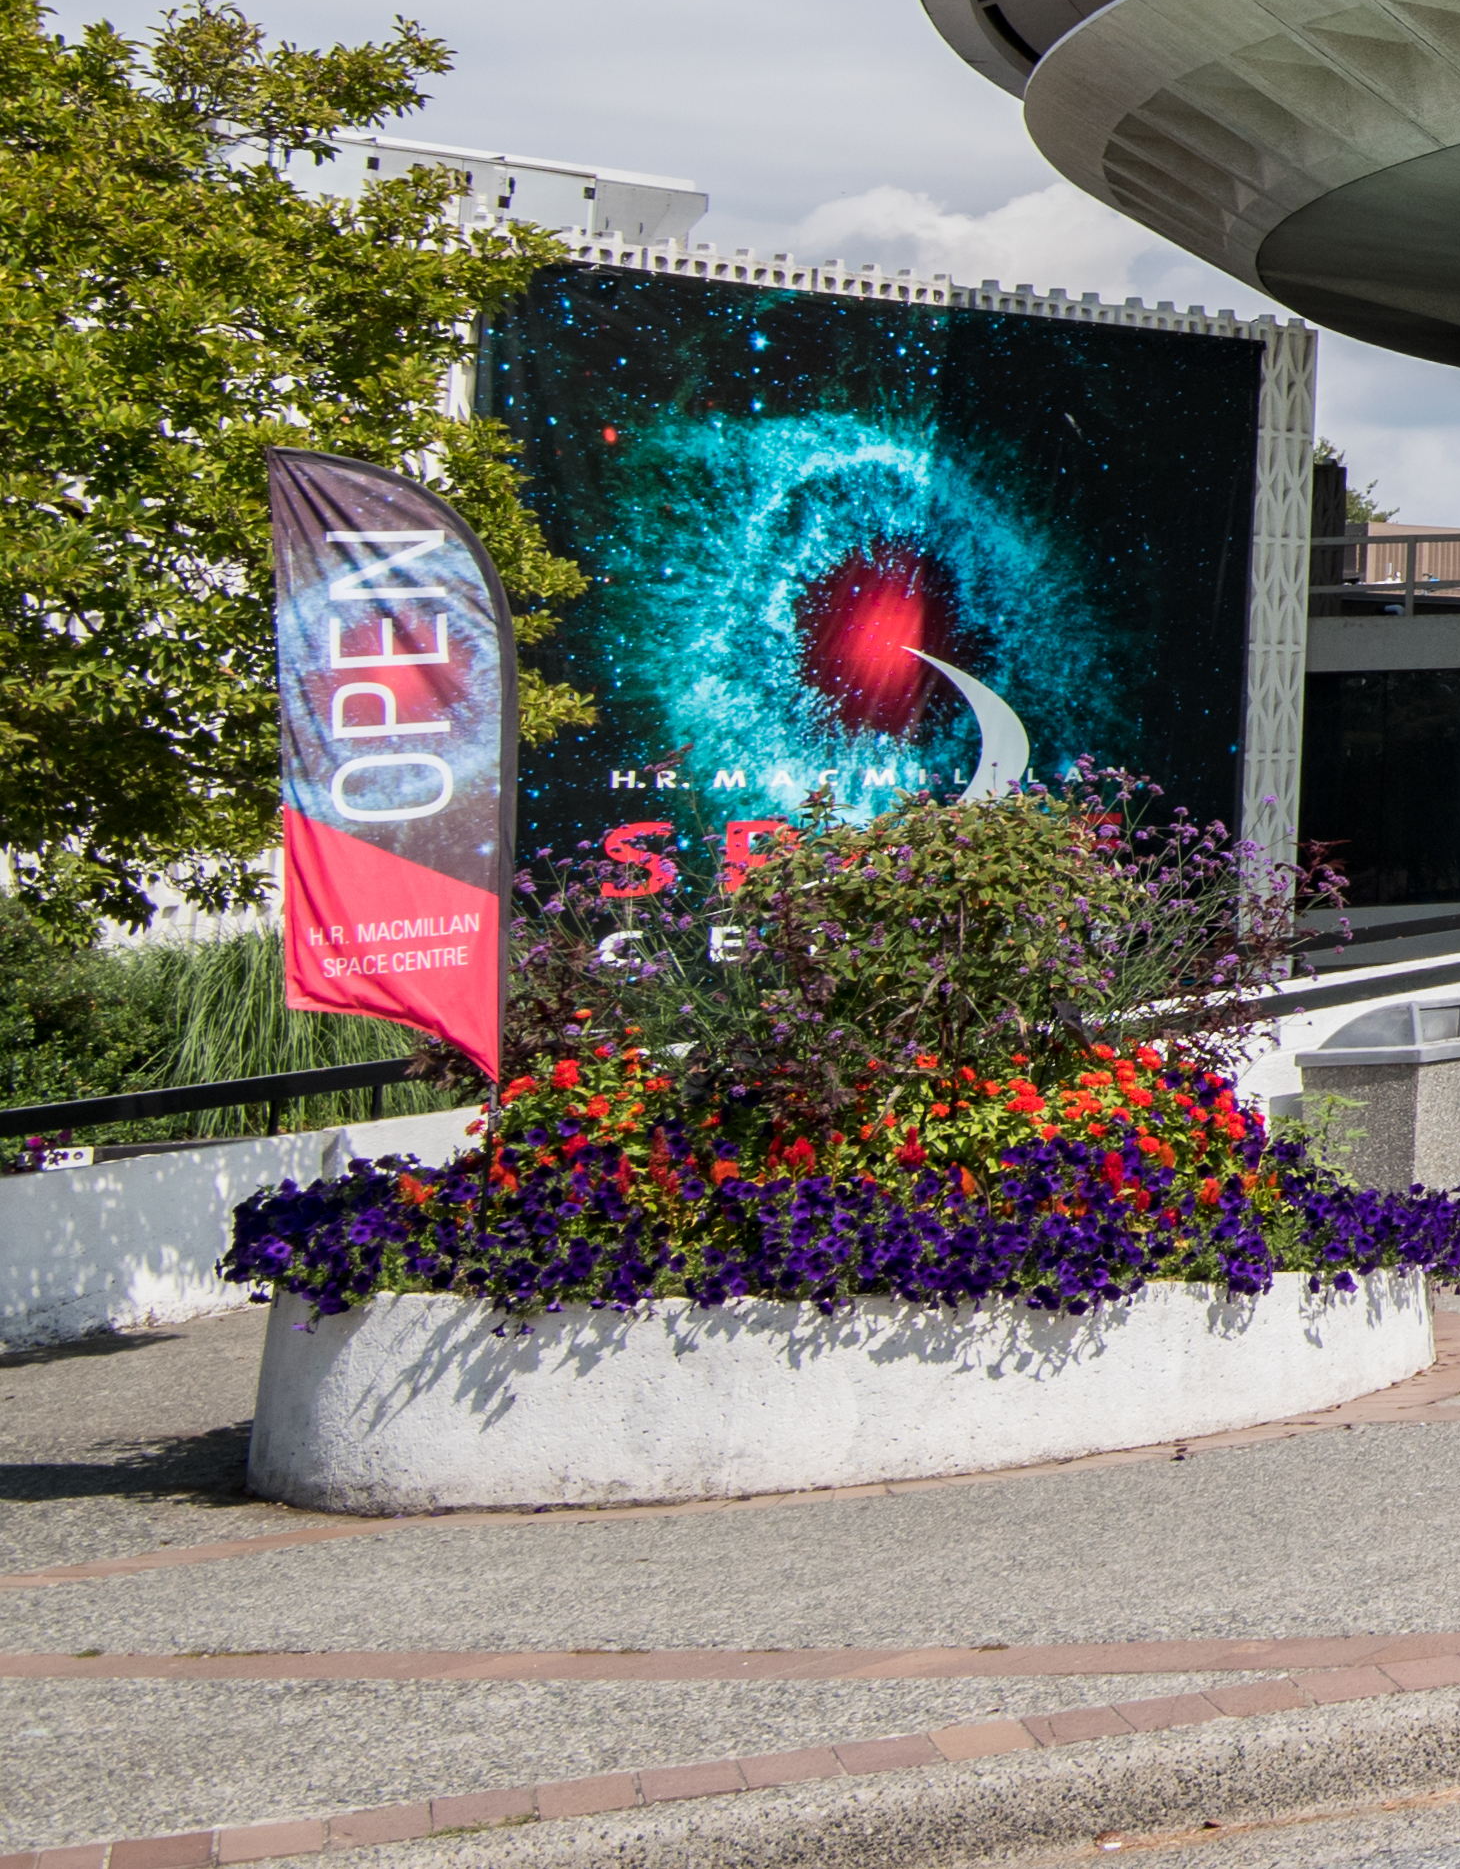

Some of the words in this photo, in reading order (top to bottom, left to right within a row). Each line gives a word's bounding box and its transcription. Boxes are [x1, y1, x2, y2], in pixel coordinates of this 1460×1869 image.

[326, 529, 454, 823] OPEN
[611, 770, 690, 789] H.R.
[309, 923, 350, 947] H.R.
[358, 912, 480, 944] MACMILLAN
[324, 953, 388, 978] SPACE
[392, 945, 469, 972] CENTRE
